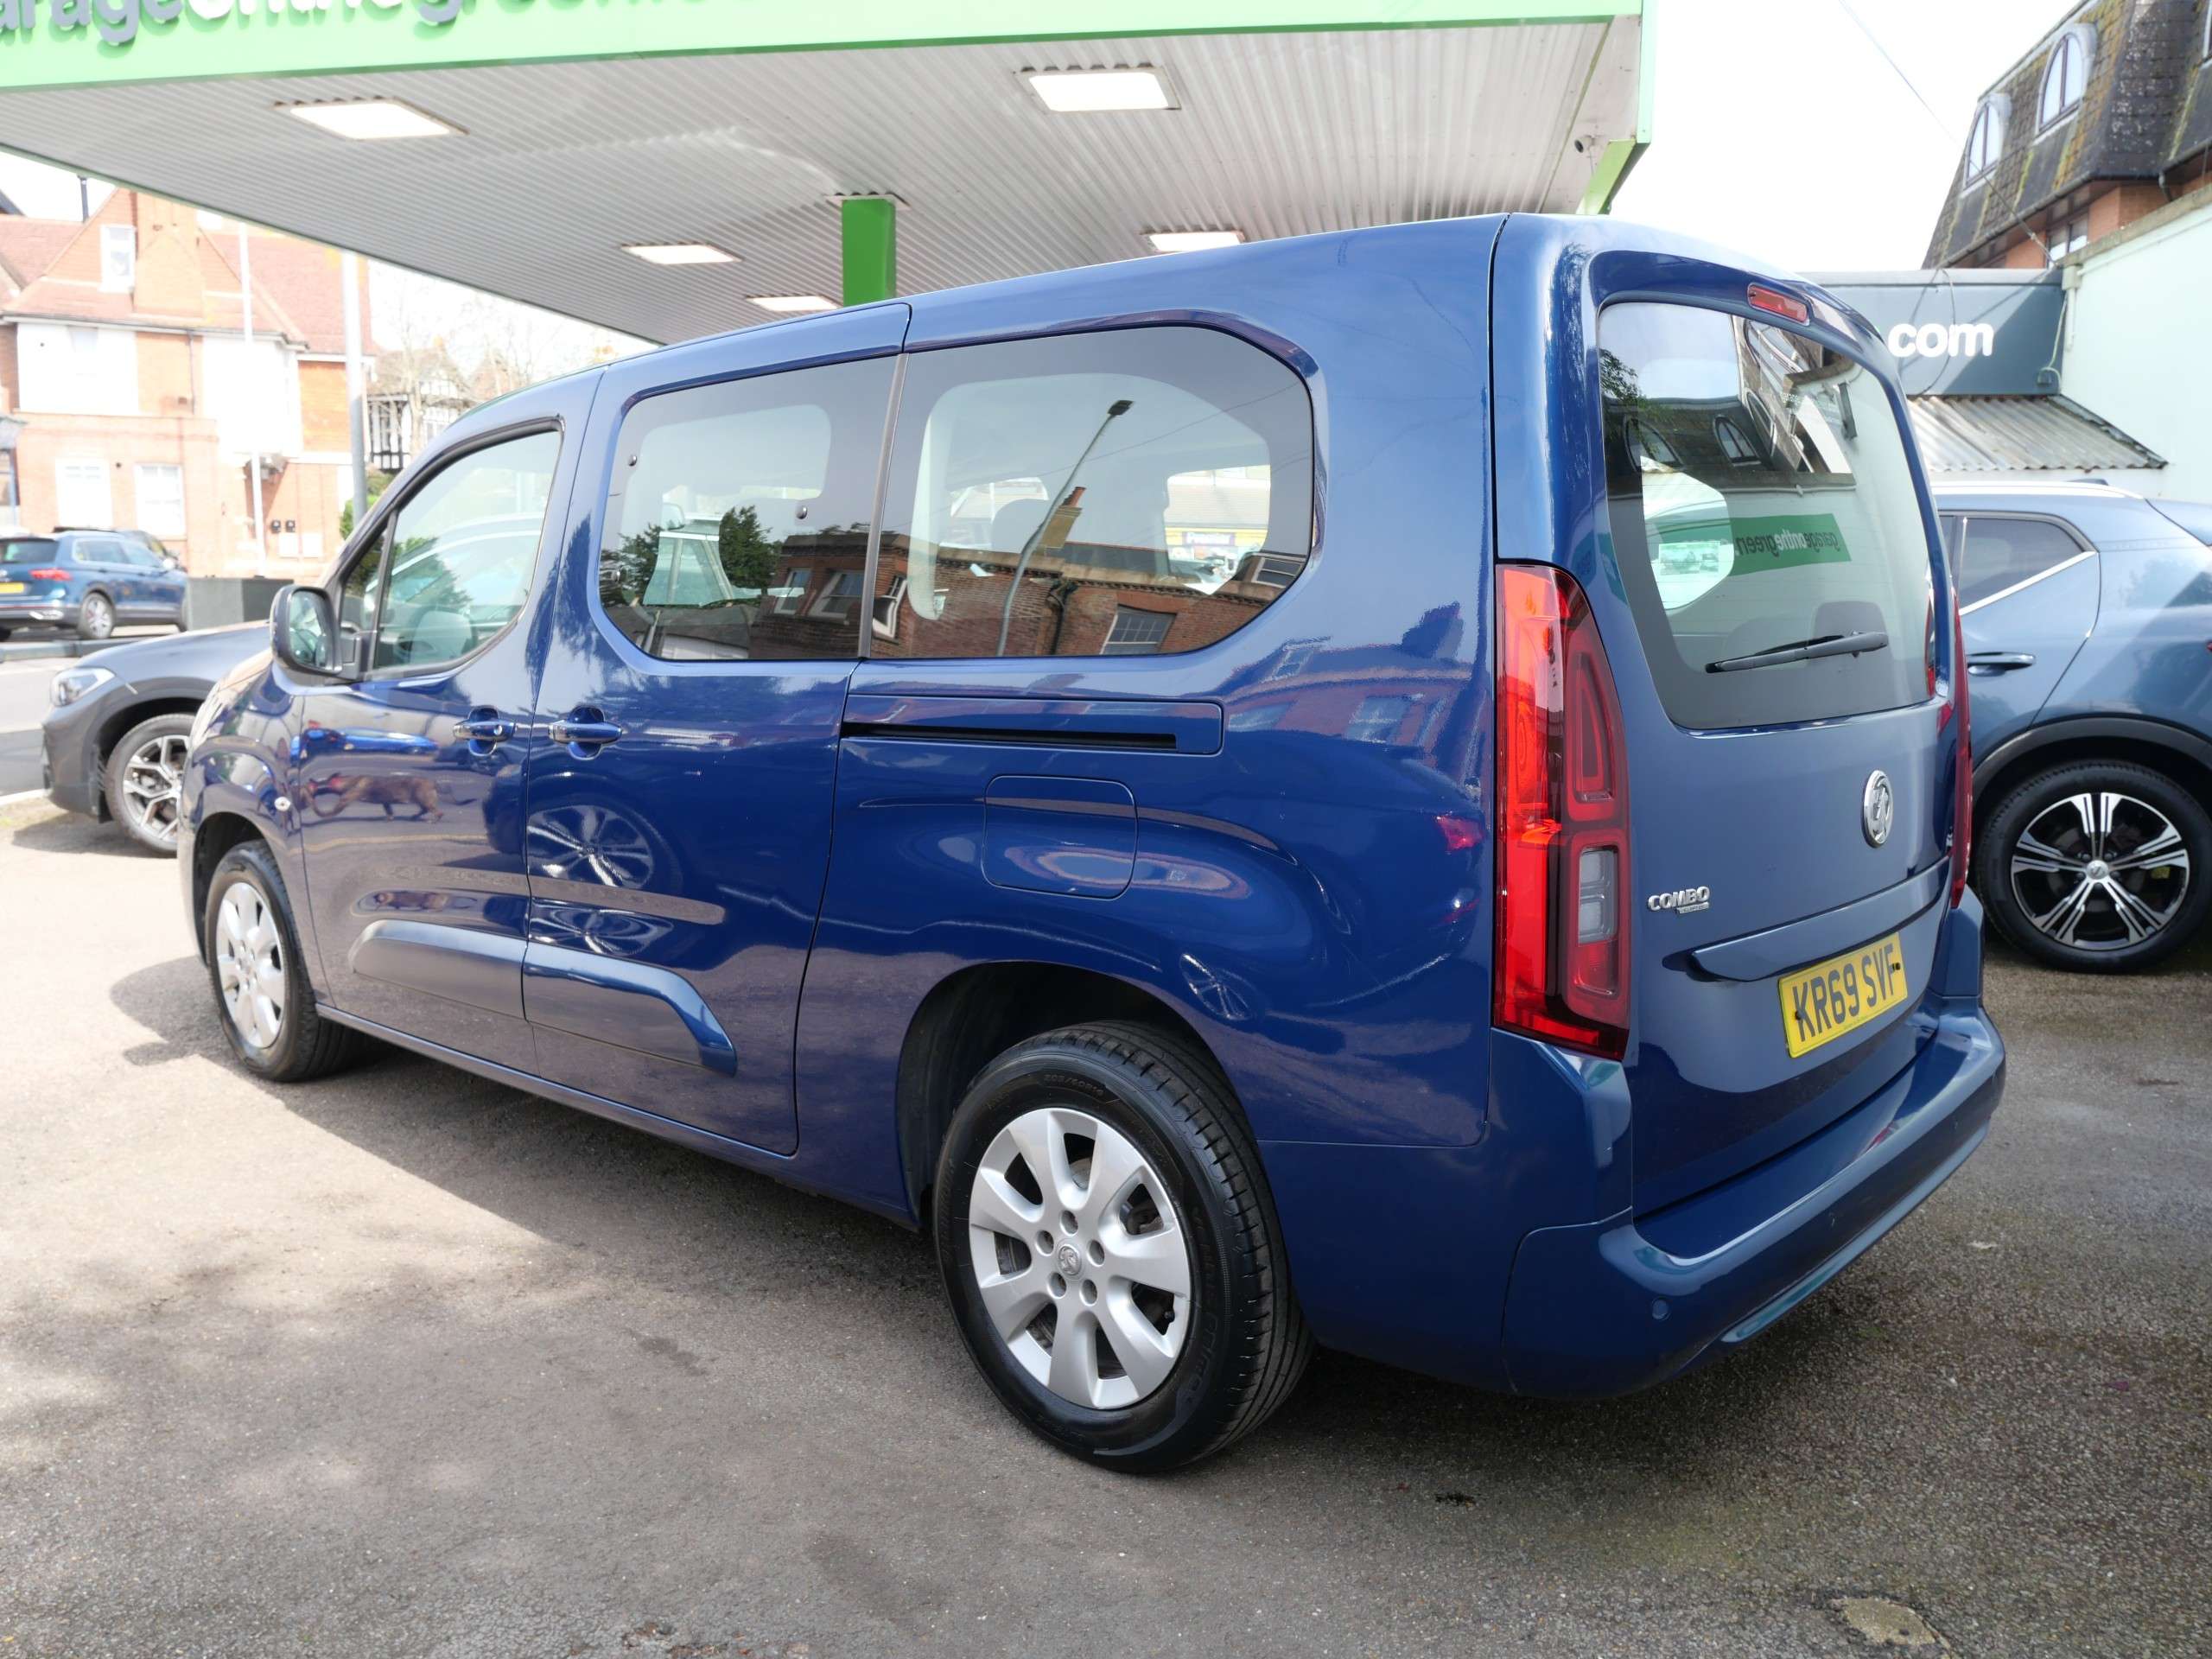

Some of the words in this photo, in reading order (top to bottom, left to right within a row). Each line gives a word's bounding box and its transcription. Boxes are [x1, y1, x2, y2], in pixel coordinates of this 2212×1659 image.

[1648, 886, 1710, 911] COMBO
[1793, 963, 1860, 1042] KR69
[1861, 943, 1895, 1007] SVF
